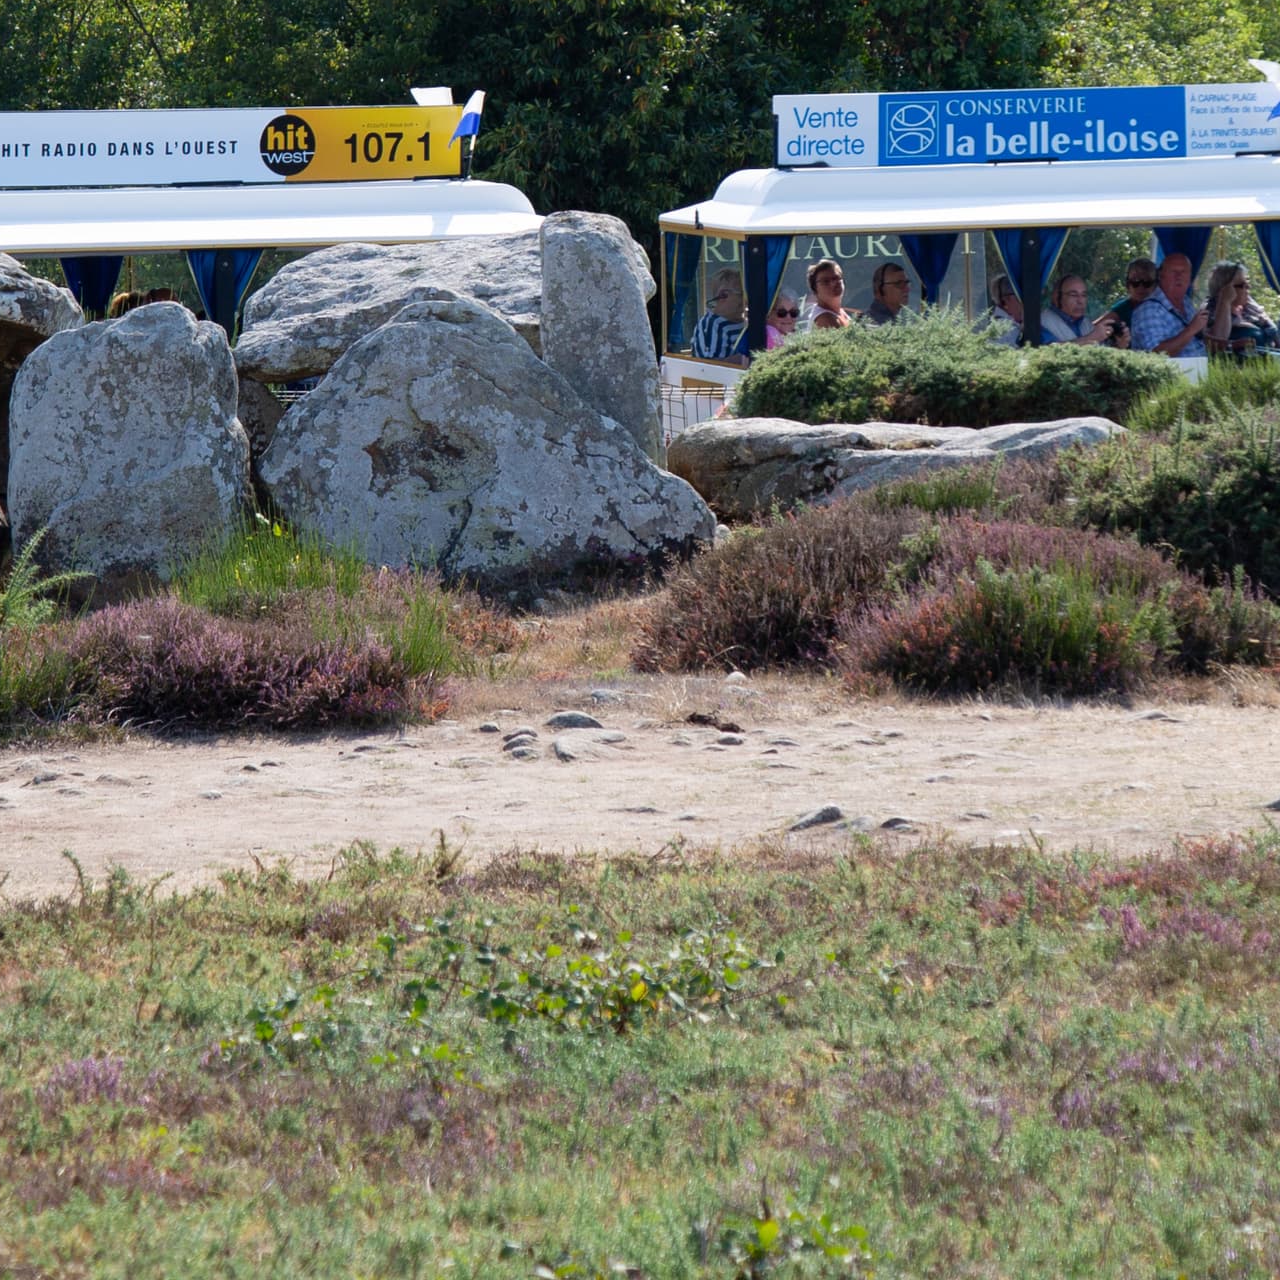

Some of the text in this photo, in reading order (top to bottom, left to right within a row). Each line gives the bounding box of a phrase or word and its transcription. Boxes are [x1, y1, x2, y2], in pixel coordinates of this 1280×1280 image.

[946, 96, 1086, 116] CONSERVERIE
[1198, 93, 1230, 102] CARNAC
[1232, 92, 1256, 101] PLAGE
[793, 107, 858, 128] Vente
[267, 124, 308, 150] hit
[344, 131, 431, 163] 107.1
[787, 134, 865, 156] directe
[946, 118, 1179, 157] la belle-iloise
[1, 143, 31, 158] HIT
[41, 142, 97, 157] RADIO
[107, 141, 155, 157] DANS
[165, 140, 239, 156] L'OUEST
[266, 150, 311, 164] west
